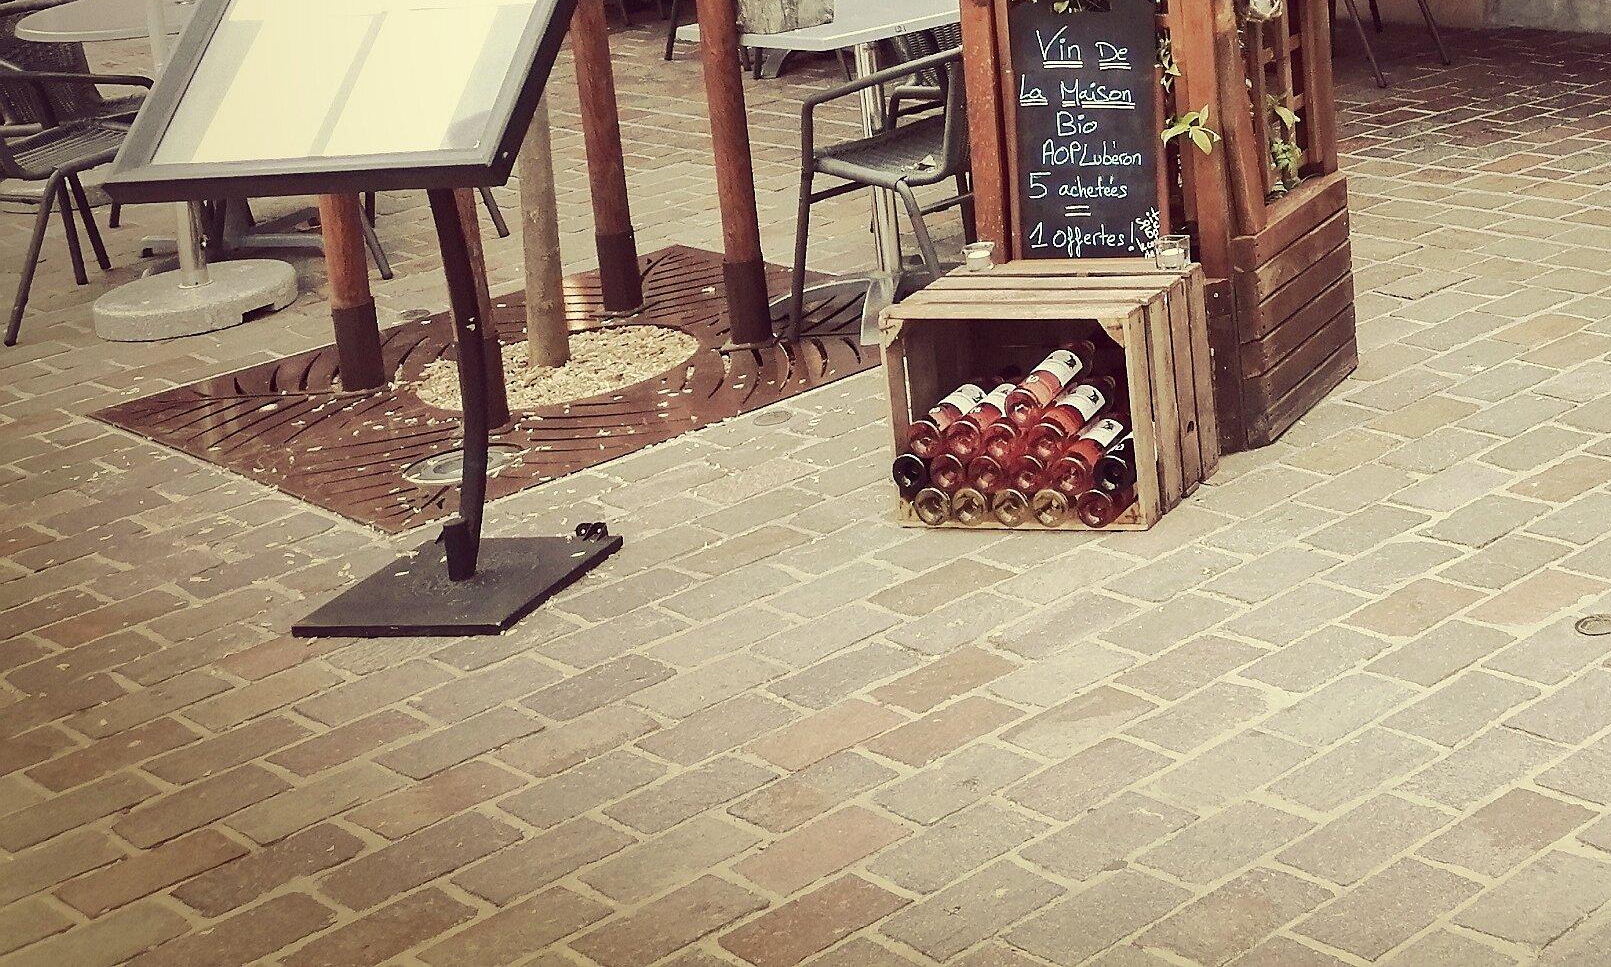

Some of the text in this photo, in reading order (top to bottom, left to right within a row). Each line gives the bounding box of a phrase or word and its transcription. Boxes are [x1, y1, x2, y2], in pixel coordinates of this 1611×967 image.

[1035, 25, 1129, 62] Vin De
[1020, 74, 1133, 103] La Maison
[1056, 110, 1098, 137] Bio
[1029, 171, 1052, 200] 5
[1029, 221, 1048, 249] 1
